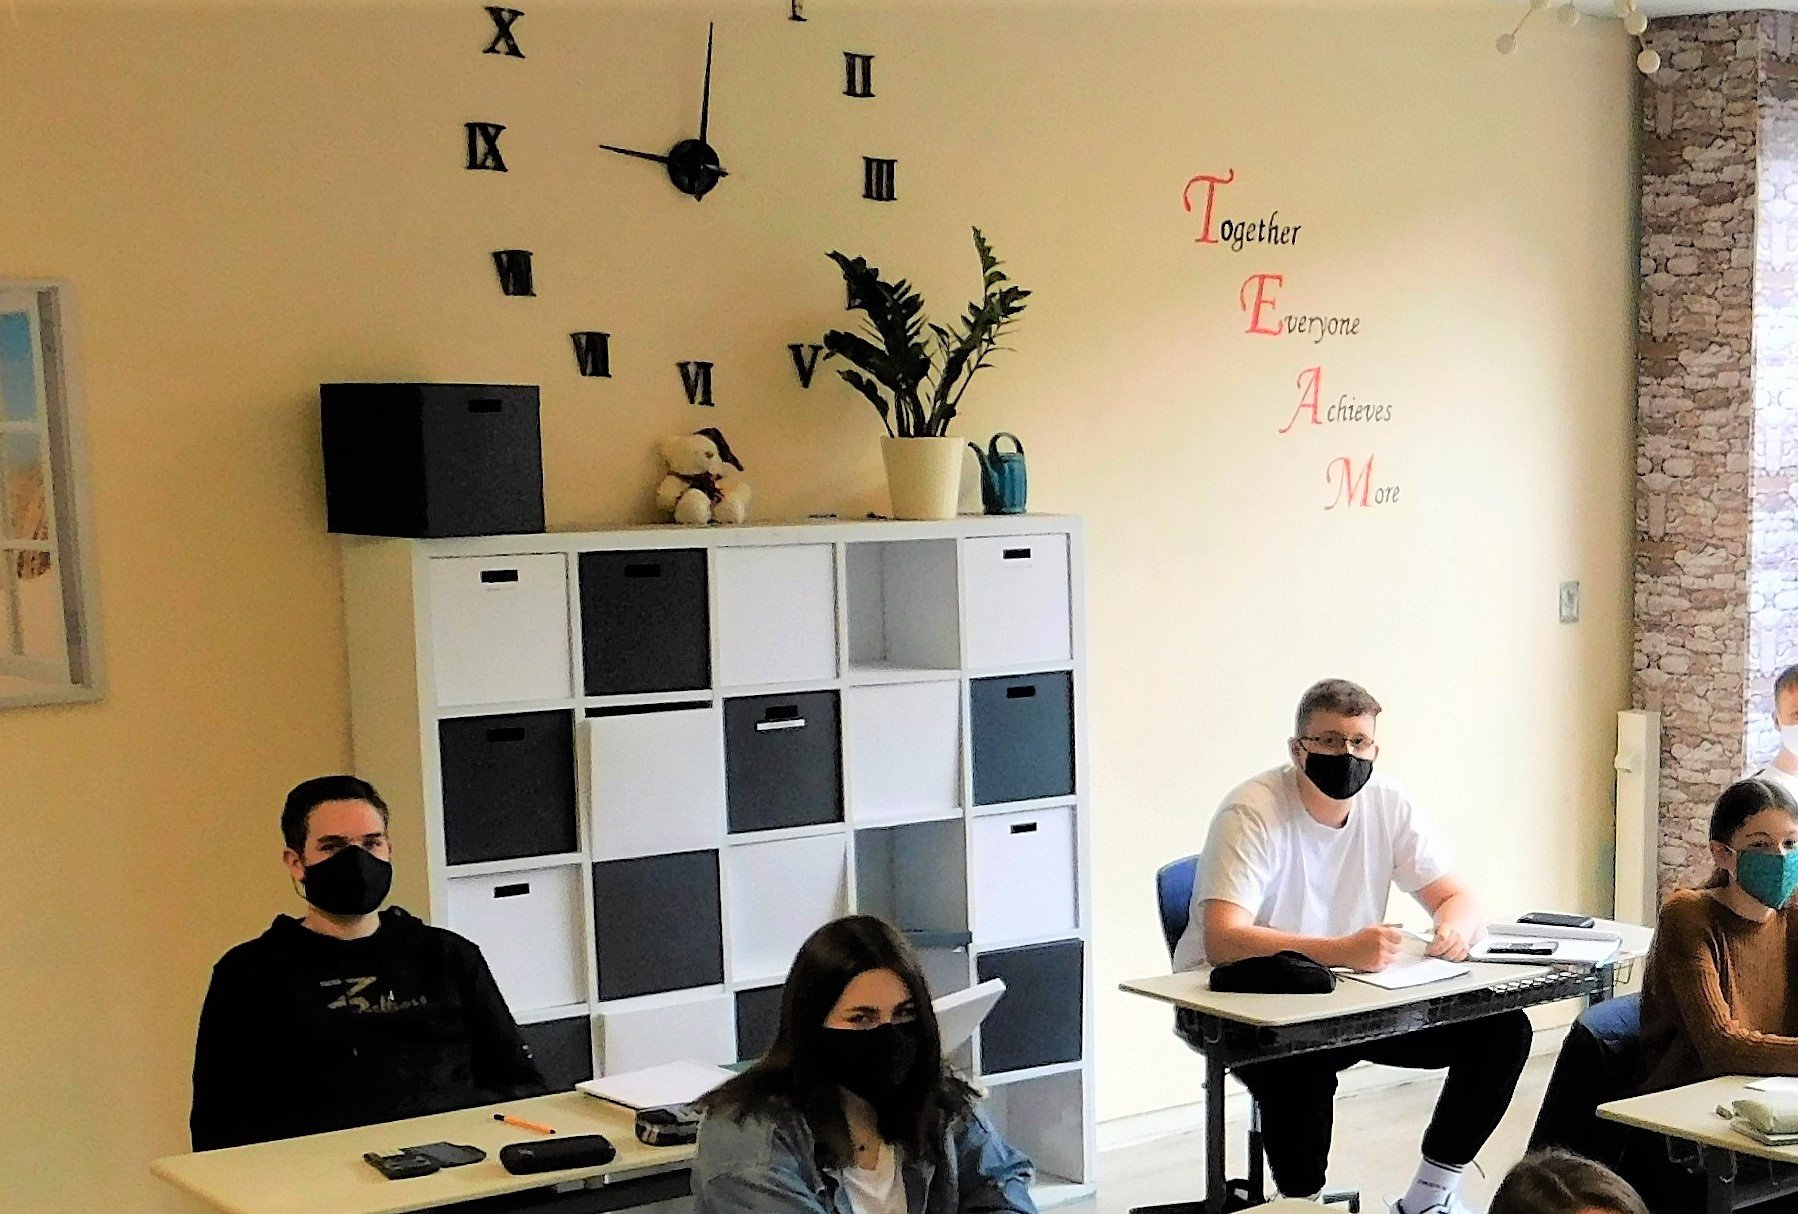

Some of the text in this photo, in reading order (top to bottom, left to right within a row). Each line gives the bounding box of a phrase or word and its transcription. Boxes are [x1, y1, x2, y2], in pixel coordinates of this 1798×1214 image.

[483, 6, 526, 58] X
[842, 52, 876, 97] II
[464, 122, 508, 172] IX
[862, 156, 898, 201] III
[1183, 168, 1301, 252] Together
[1240, 274, 1360, 344] Everyone
[675, 361, 715, 406] VI
[788, 343, 824, 388] V
[1279, 366, 1392, 433] Achieves
[1324, 453, 1400, 511] More
